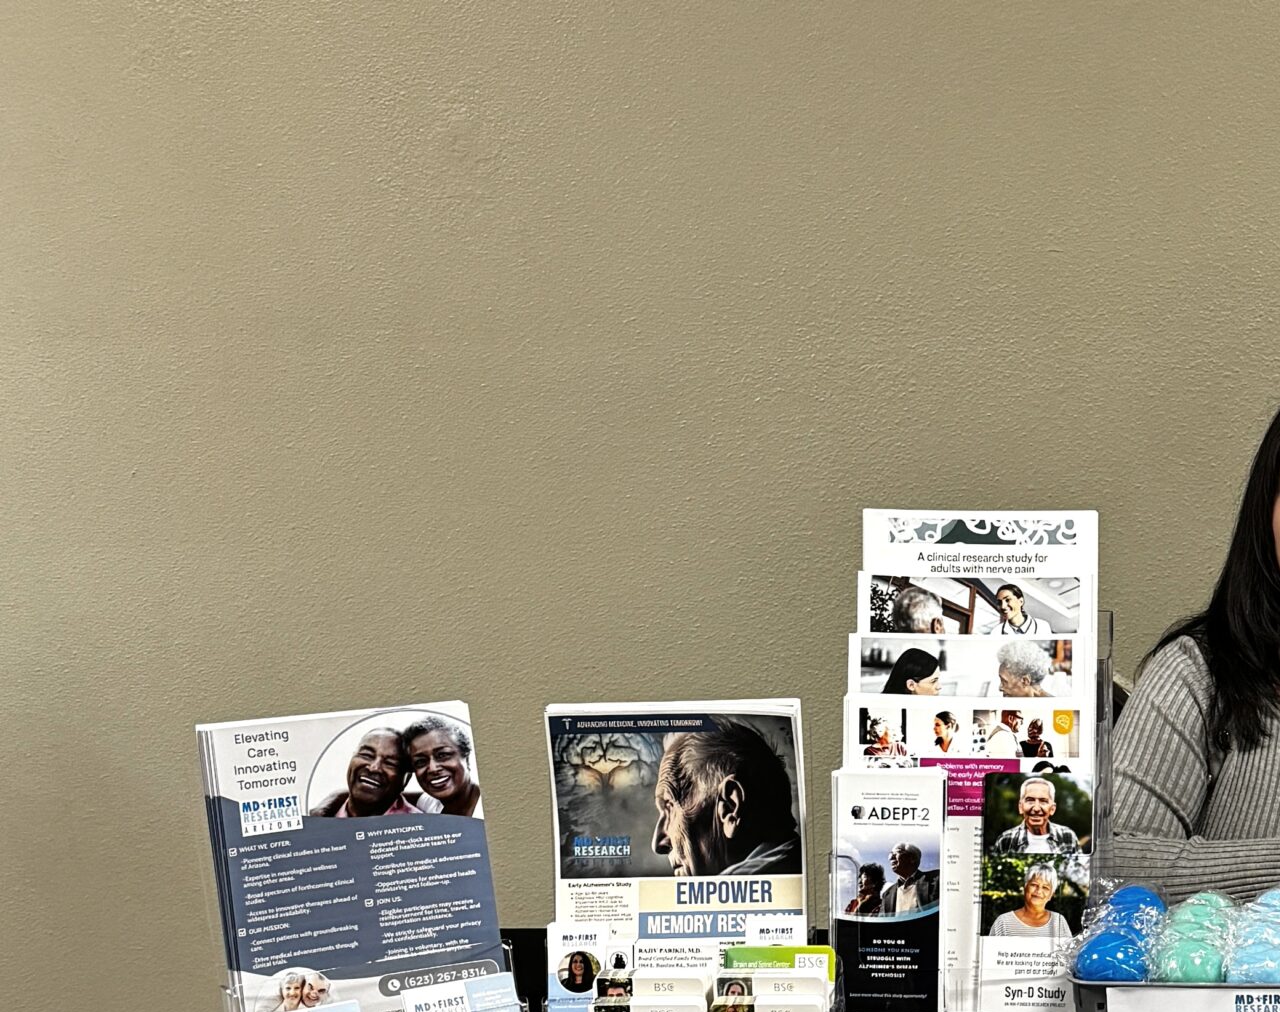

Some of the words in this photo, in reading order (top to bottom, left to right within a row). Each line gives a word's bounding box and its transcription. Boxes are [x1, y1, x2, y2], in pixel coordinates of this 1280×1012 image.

[917, 552, 925, 561] A
[927, 552, 961, 562] clinical
[962, 553, 1004, 563] research
[1006, 553, 1032, 564] study
[1034, 553, 1048, 563] for
[234, 731, 289, 744] Elevating
[247, 748, 278, 758] Care,
[234, 761, 296, 775] Innovating
[237, 777, 296, 790] Tomorrow
[868, 807, 929, 821] ADEPT-2
[574, 846, 630, 857] RESEARCH
[677, 880, 772, 904] EMPOWER
[648, 915, 713, 933] MEMORY
[405, 972, 435, 988] (623)
[437, 966, 487, 982] 267-8314
[1005, 986, 1034, 1000] Syn-D
[1037, 987, 1066, 1001] Study
[1235, 995, 1255, 1005] MD
